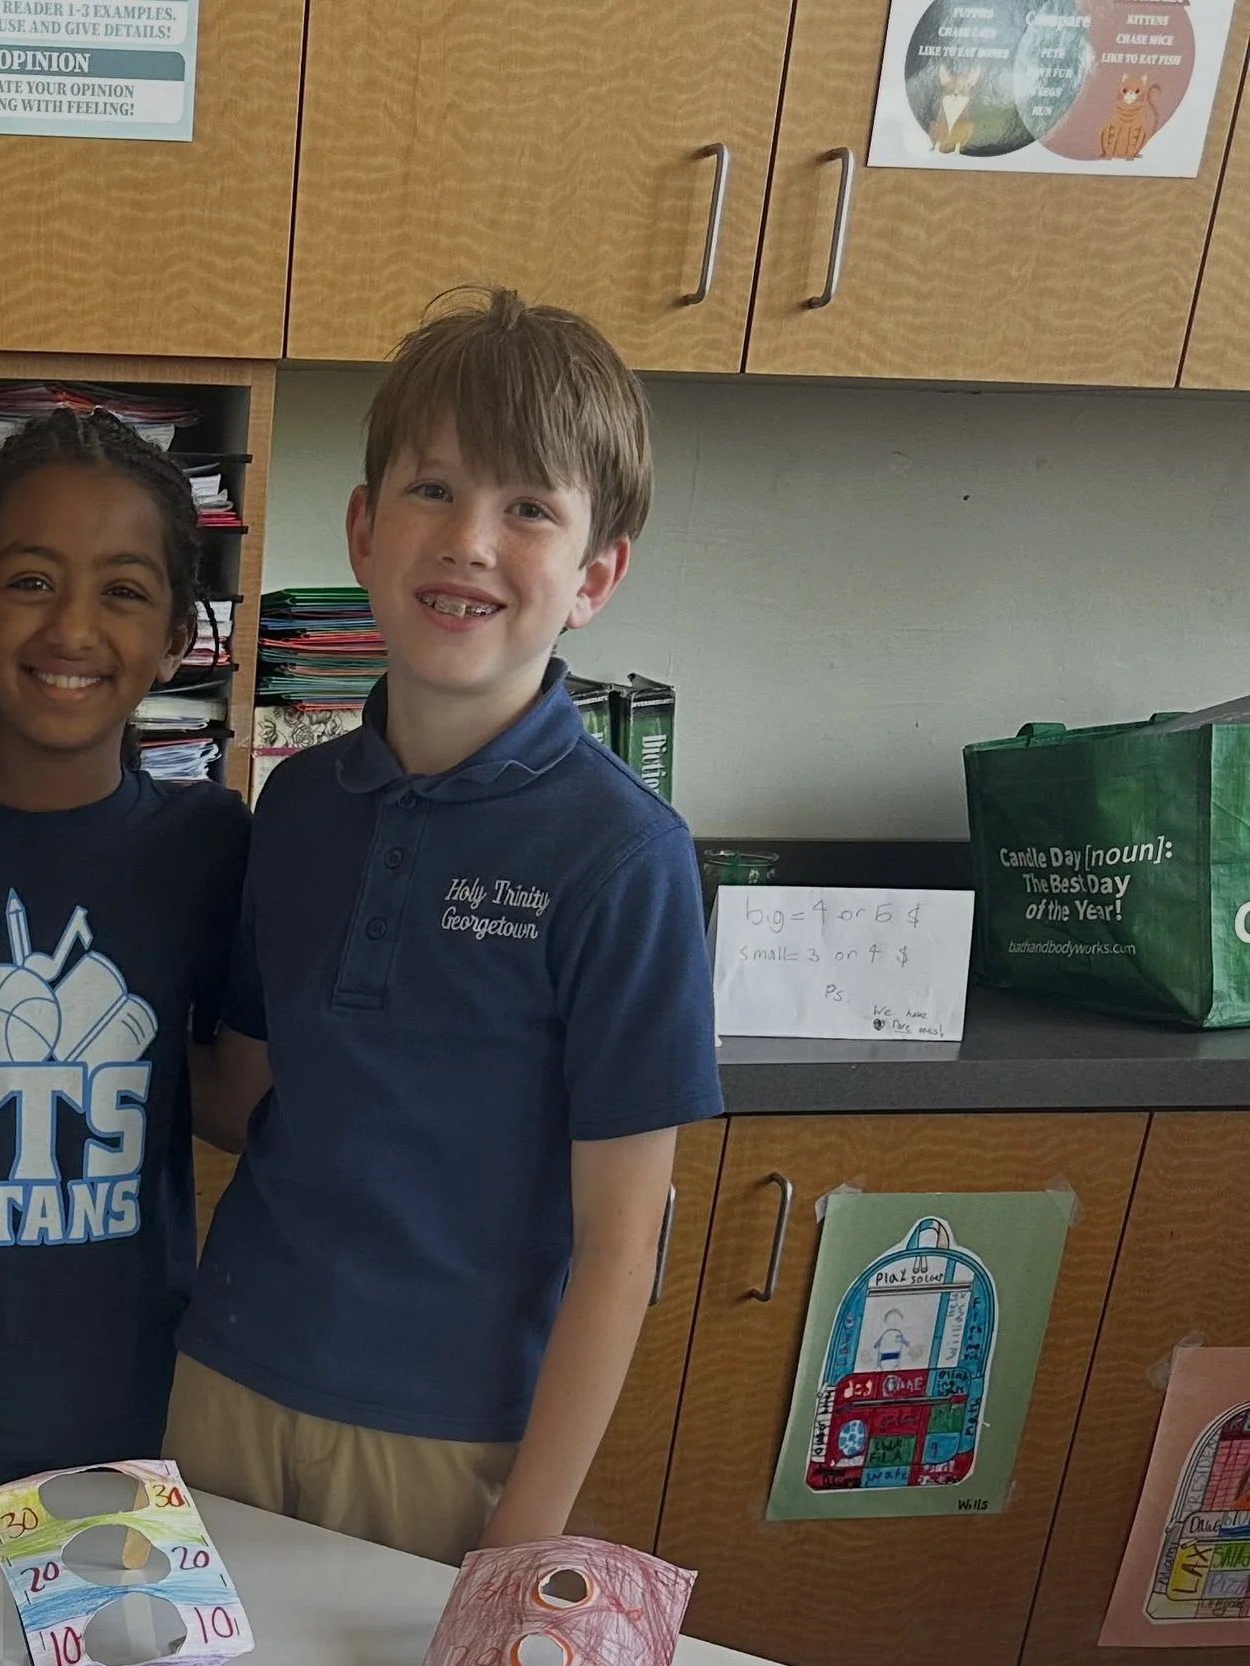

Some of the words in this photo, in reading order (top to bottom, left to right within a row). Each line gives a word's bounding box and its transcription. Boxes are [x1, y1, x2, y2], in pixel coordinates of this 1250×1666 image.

[2, 1, 64, 16] READER
[68, 4, 90, 17] 1-3
[93, 5, 177, 21] EXAMPLES.
[1025, 11, 1092, 31] Compare
[1126, 14, 1171, 26] KITTENS
[28, 21, 61, 34] AND
[65, 22, 101, 36] GIVE
[104, 24, 171, 39] DETAILS!
[1116, 33, 1148, 45] CHASE
[1149, 34, 1175, 46] MICE
[918, 45, 942, 56] LIKE
[943, 47, 957, 57] TO
[957, 48, 975, 58] EAT
[1101, 53, 1124, 64] LIKE
[1125, 54, 1138, 64] TO
[1139, 54, 1159, 65] EAT
[1159, 55, 1182, 66] FISH
[27, 81, 67, 96] YOUR
[70, 83, 135, 98] OPINION
[21, 99, 63, 113] WITH
[67, 101, 135, 116] FEELING!
[1032, 106, 1054, 117] RUN
[1000, 847, 1047, 869] Candle
[1050, 847, 1082, 871] Day
[1084, 836, 1173, 871] [noun]:
[1022, 873, 1049, 893] The
[1049, 874, 1086, 894] Best
[1087, 874, 1131, 898] Day
[444, 877, 487, 909] Holy
[492, 879, 551, 916] Trinity
[746, 896, 785, 933] big
[837, 908, 865, 921] or
[907, 903, 921, 929] $
[1025, 898, 1047, 920] of
[1047, 899, 1070, 921] the
[1074, 899, 1122, 921] Year!
[441, 906, 539, 940] Georgetown
[807, 948, 820, 963] 3
[835, 947, 858, 961] or
[869, 943, 882, 963] 4
[896, 945, 908, 968] $
[1008, 939, 1136, 957] bathandbodyworks.com
[873, 1005, 892, 1017] We
[906, 1008, 928, 1019] have
[0, 1507, 39, 1538] 30
[152, 1484, 186, 1508] 30
[956, 1497, 988, 1511] Wills
[20, 1561, 60, 1593] 20
[171, 1546, 209, 1570] 20
[193, 1606, 234, 1644] 10
